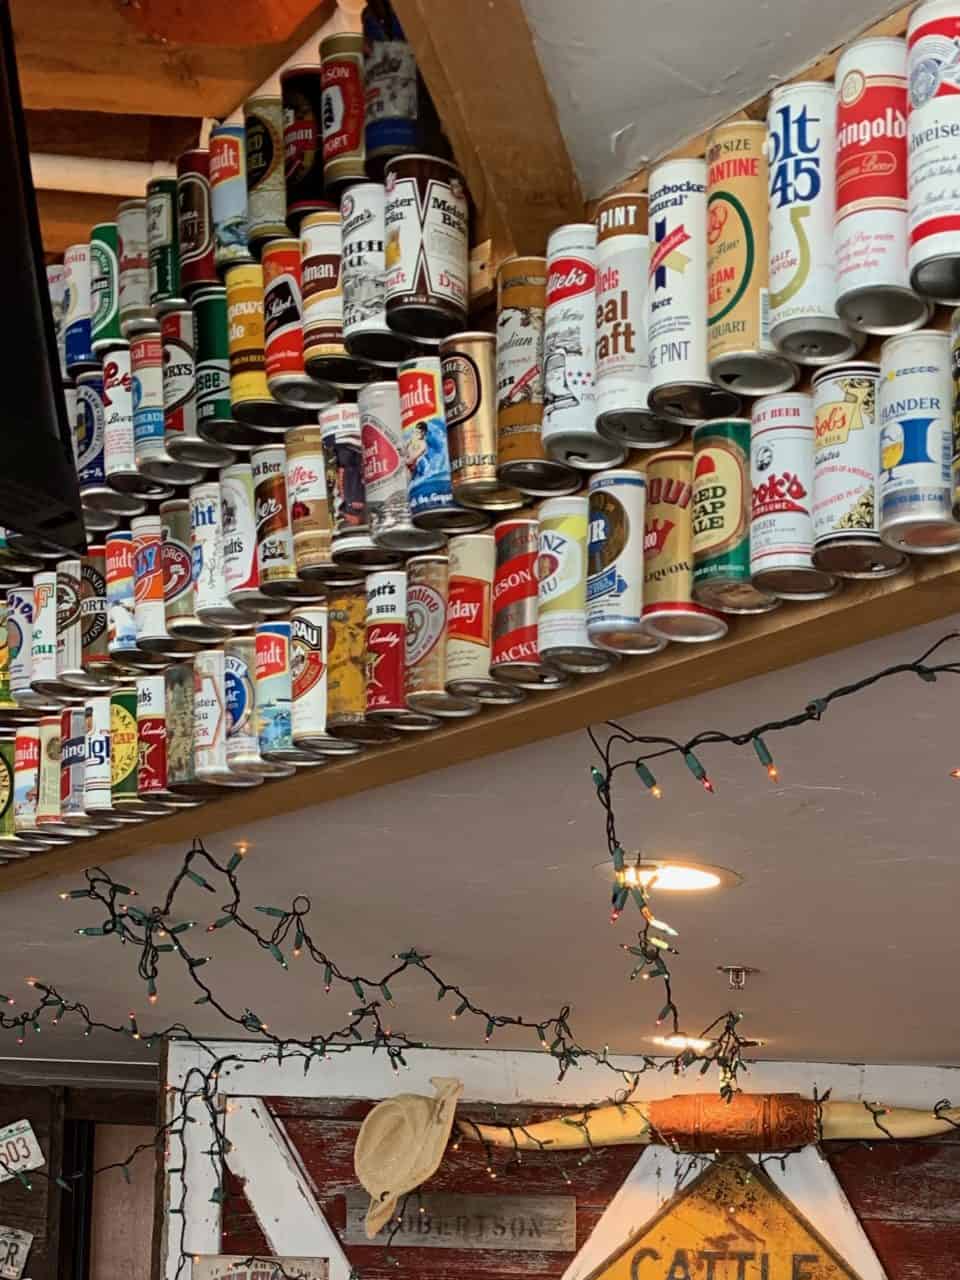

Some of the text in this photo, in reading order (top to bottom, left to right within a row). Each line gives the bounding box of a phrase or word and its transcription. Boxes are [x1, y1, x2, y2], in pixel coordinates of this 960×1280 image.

[723, 138, 751, 152] SIZE
[770, 157, 821, 209] 45
[600, 205, 637, 231] PINT
[661, 340, 691, 366] PINT
